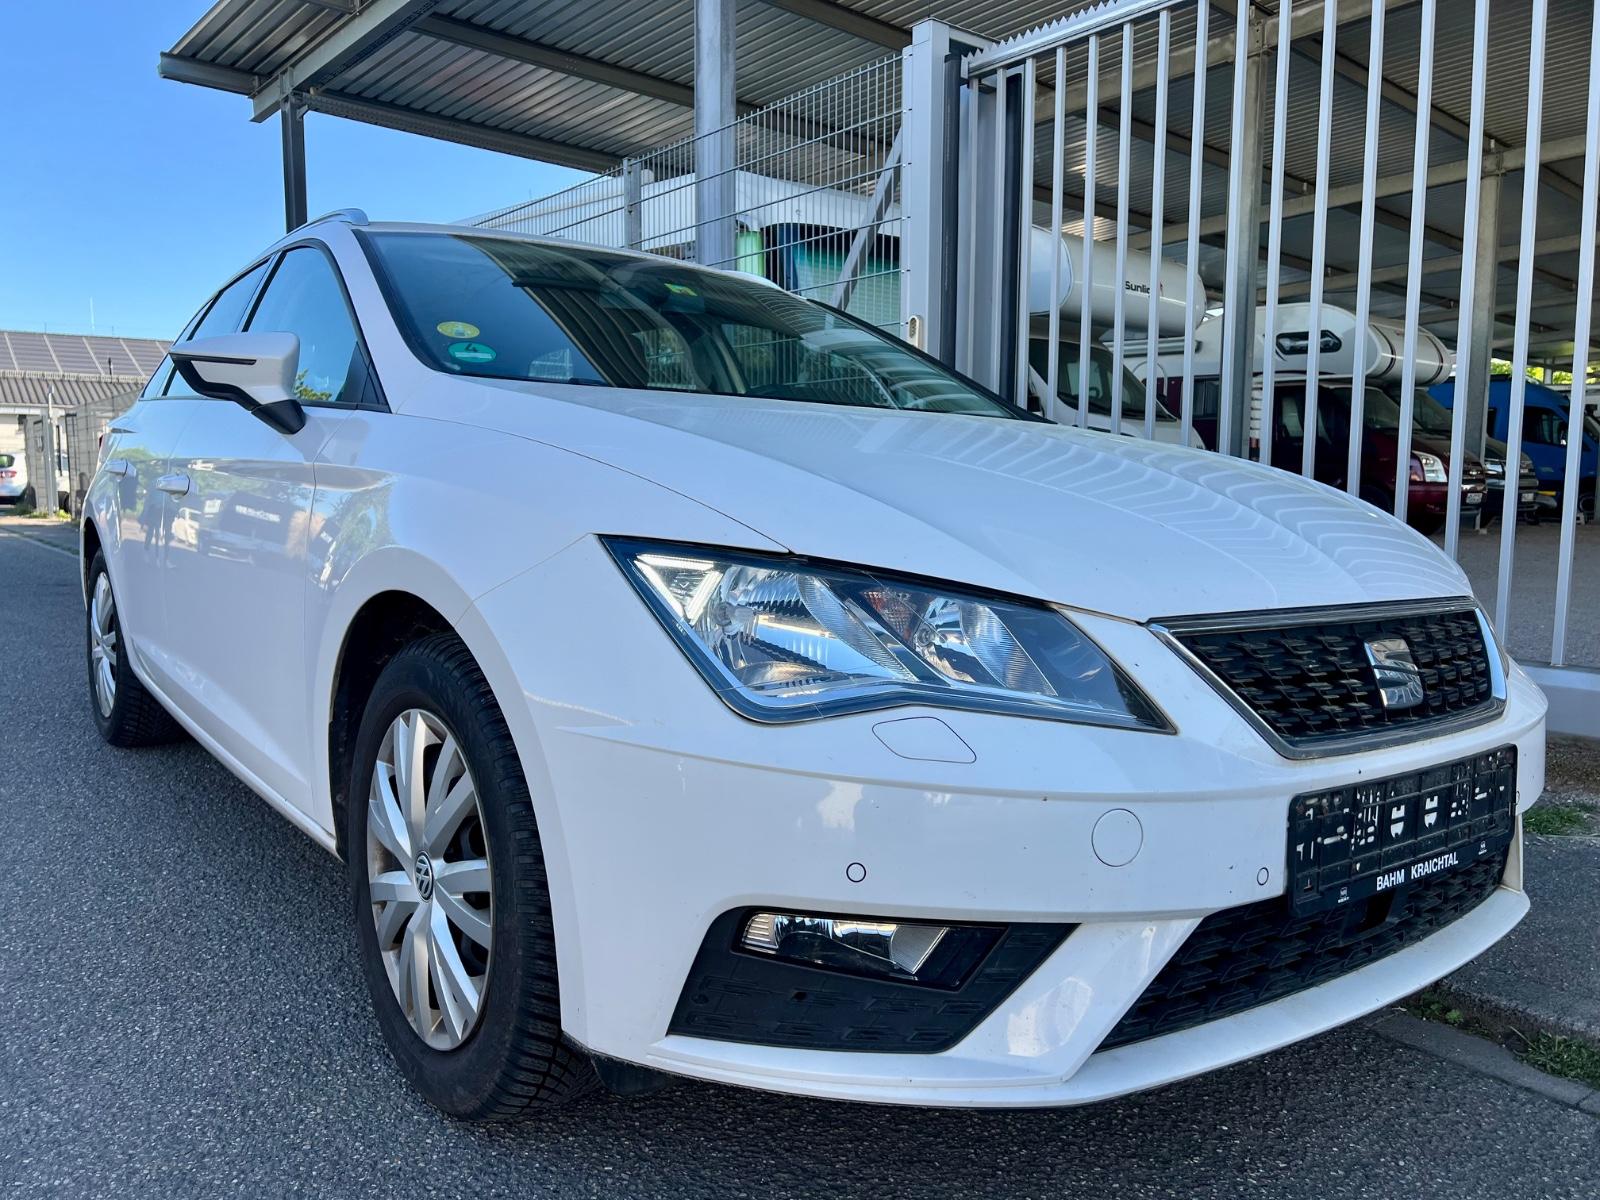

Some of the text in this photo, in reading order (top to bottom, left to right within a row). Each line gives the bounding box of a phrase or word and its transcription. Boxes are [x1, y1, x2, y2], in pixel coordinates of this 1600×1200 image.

[464, 343, 478, 352] 4
[1376, 851, 1459, 892] BAHM KRAICHTAL
